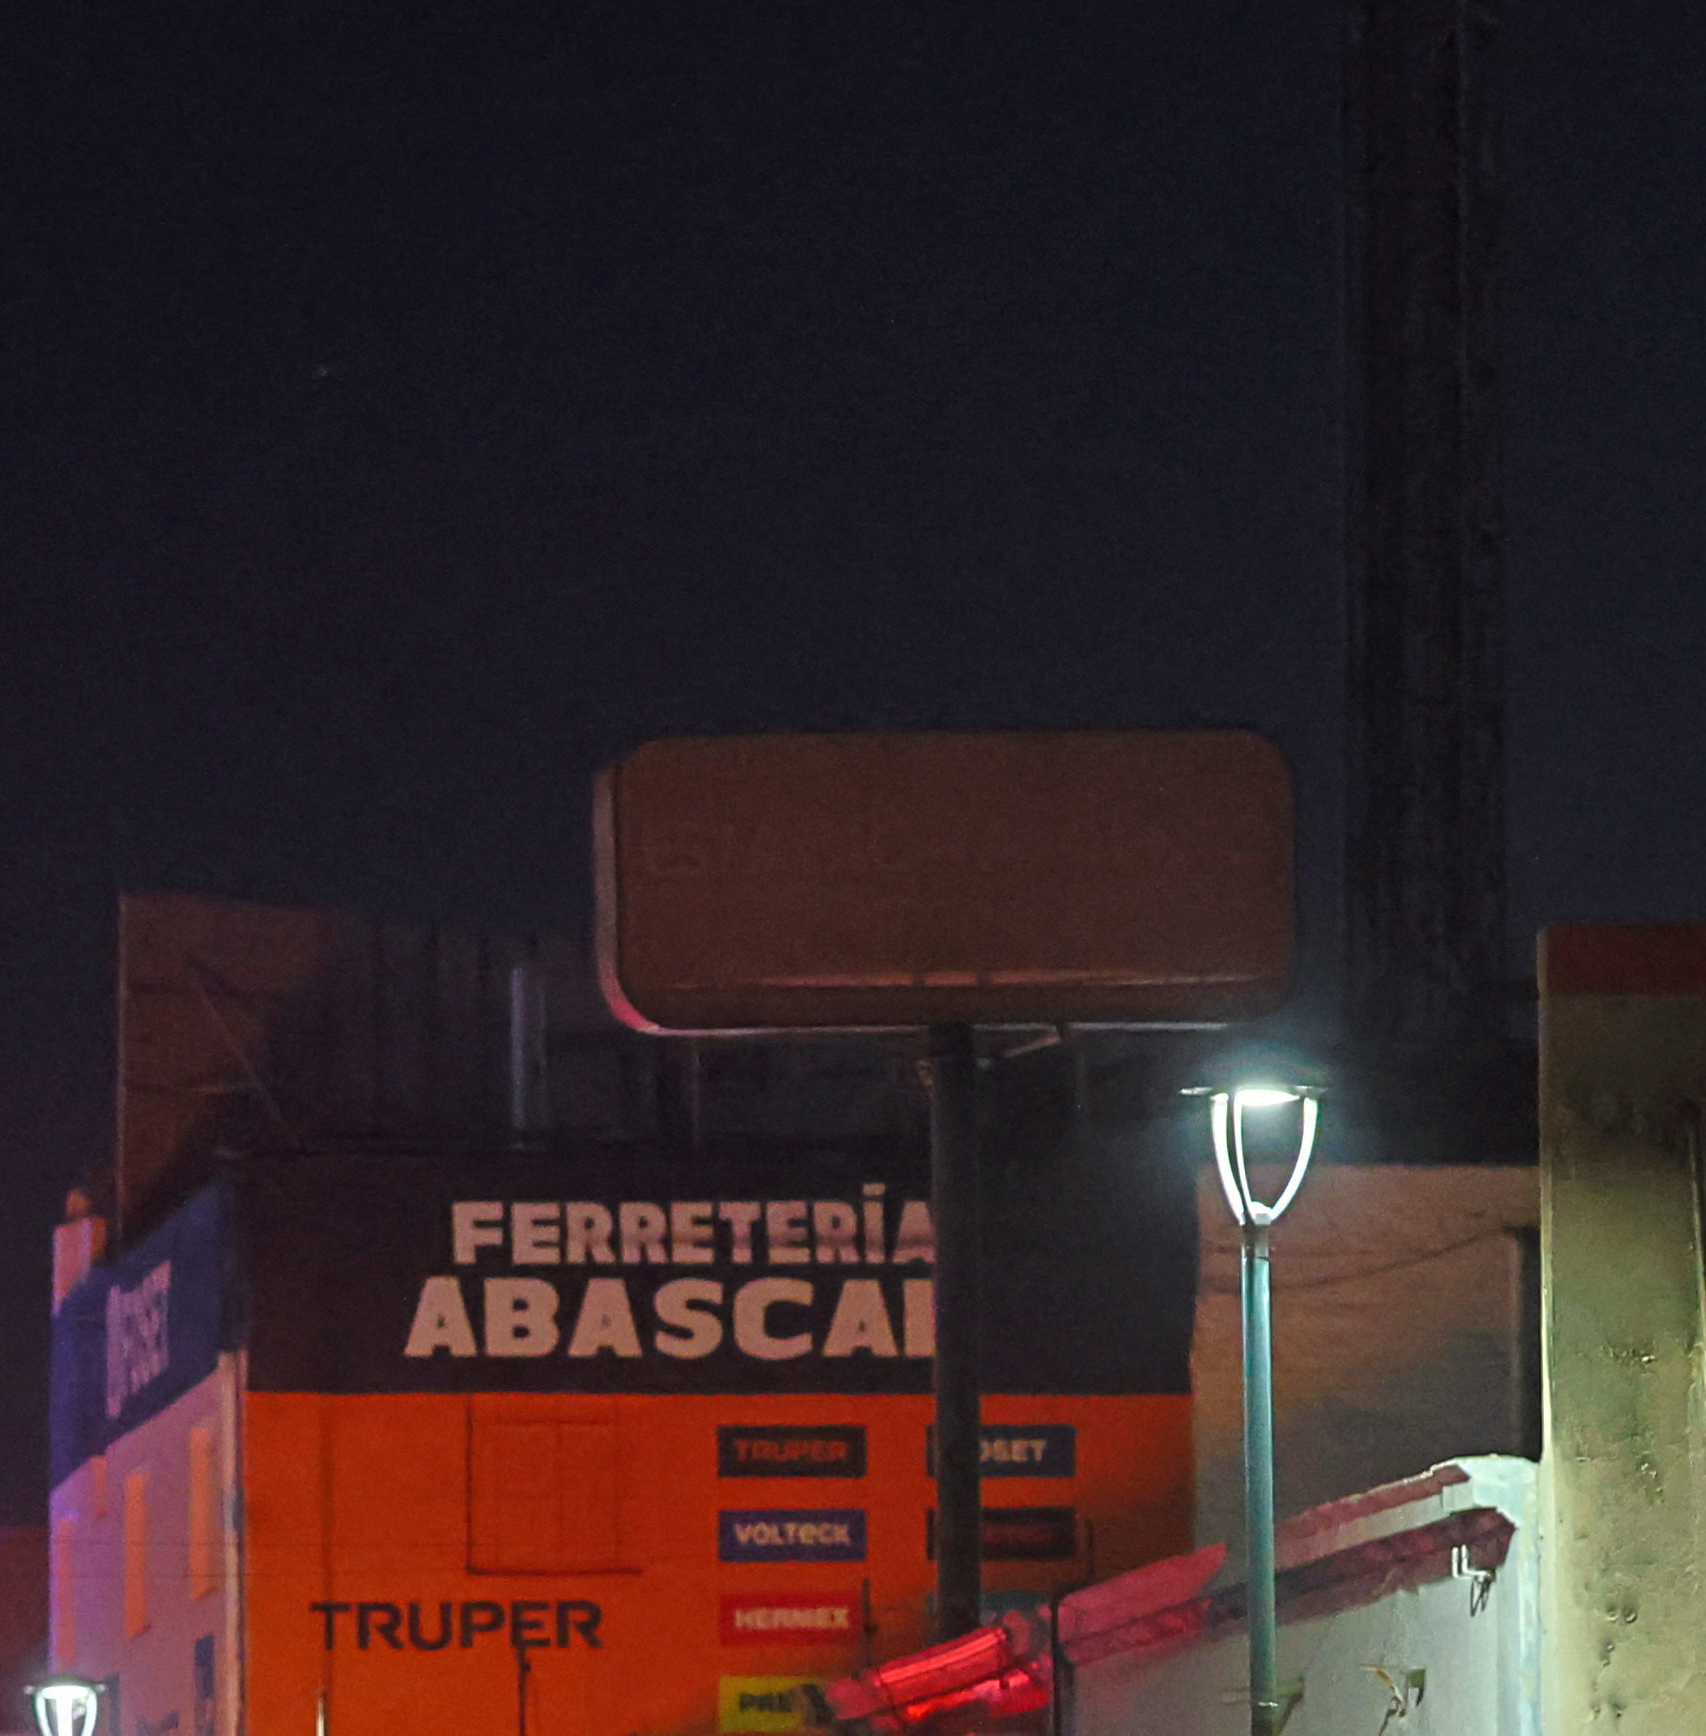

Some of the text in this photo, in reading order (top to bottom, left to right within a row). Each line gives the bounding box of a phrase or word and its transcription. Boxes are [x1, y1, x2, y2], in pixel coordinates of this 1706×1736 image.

[734, 1440, 848, 1462] TRUPER
[980, 1438, 1047, 1462] OSET
[310, 1601, 603, 1650] TRUPER
[735, 1607, 849, 1629] HERMEX
